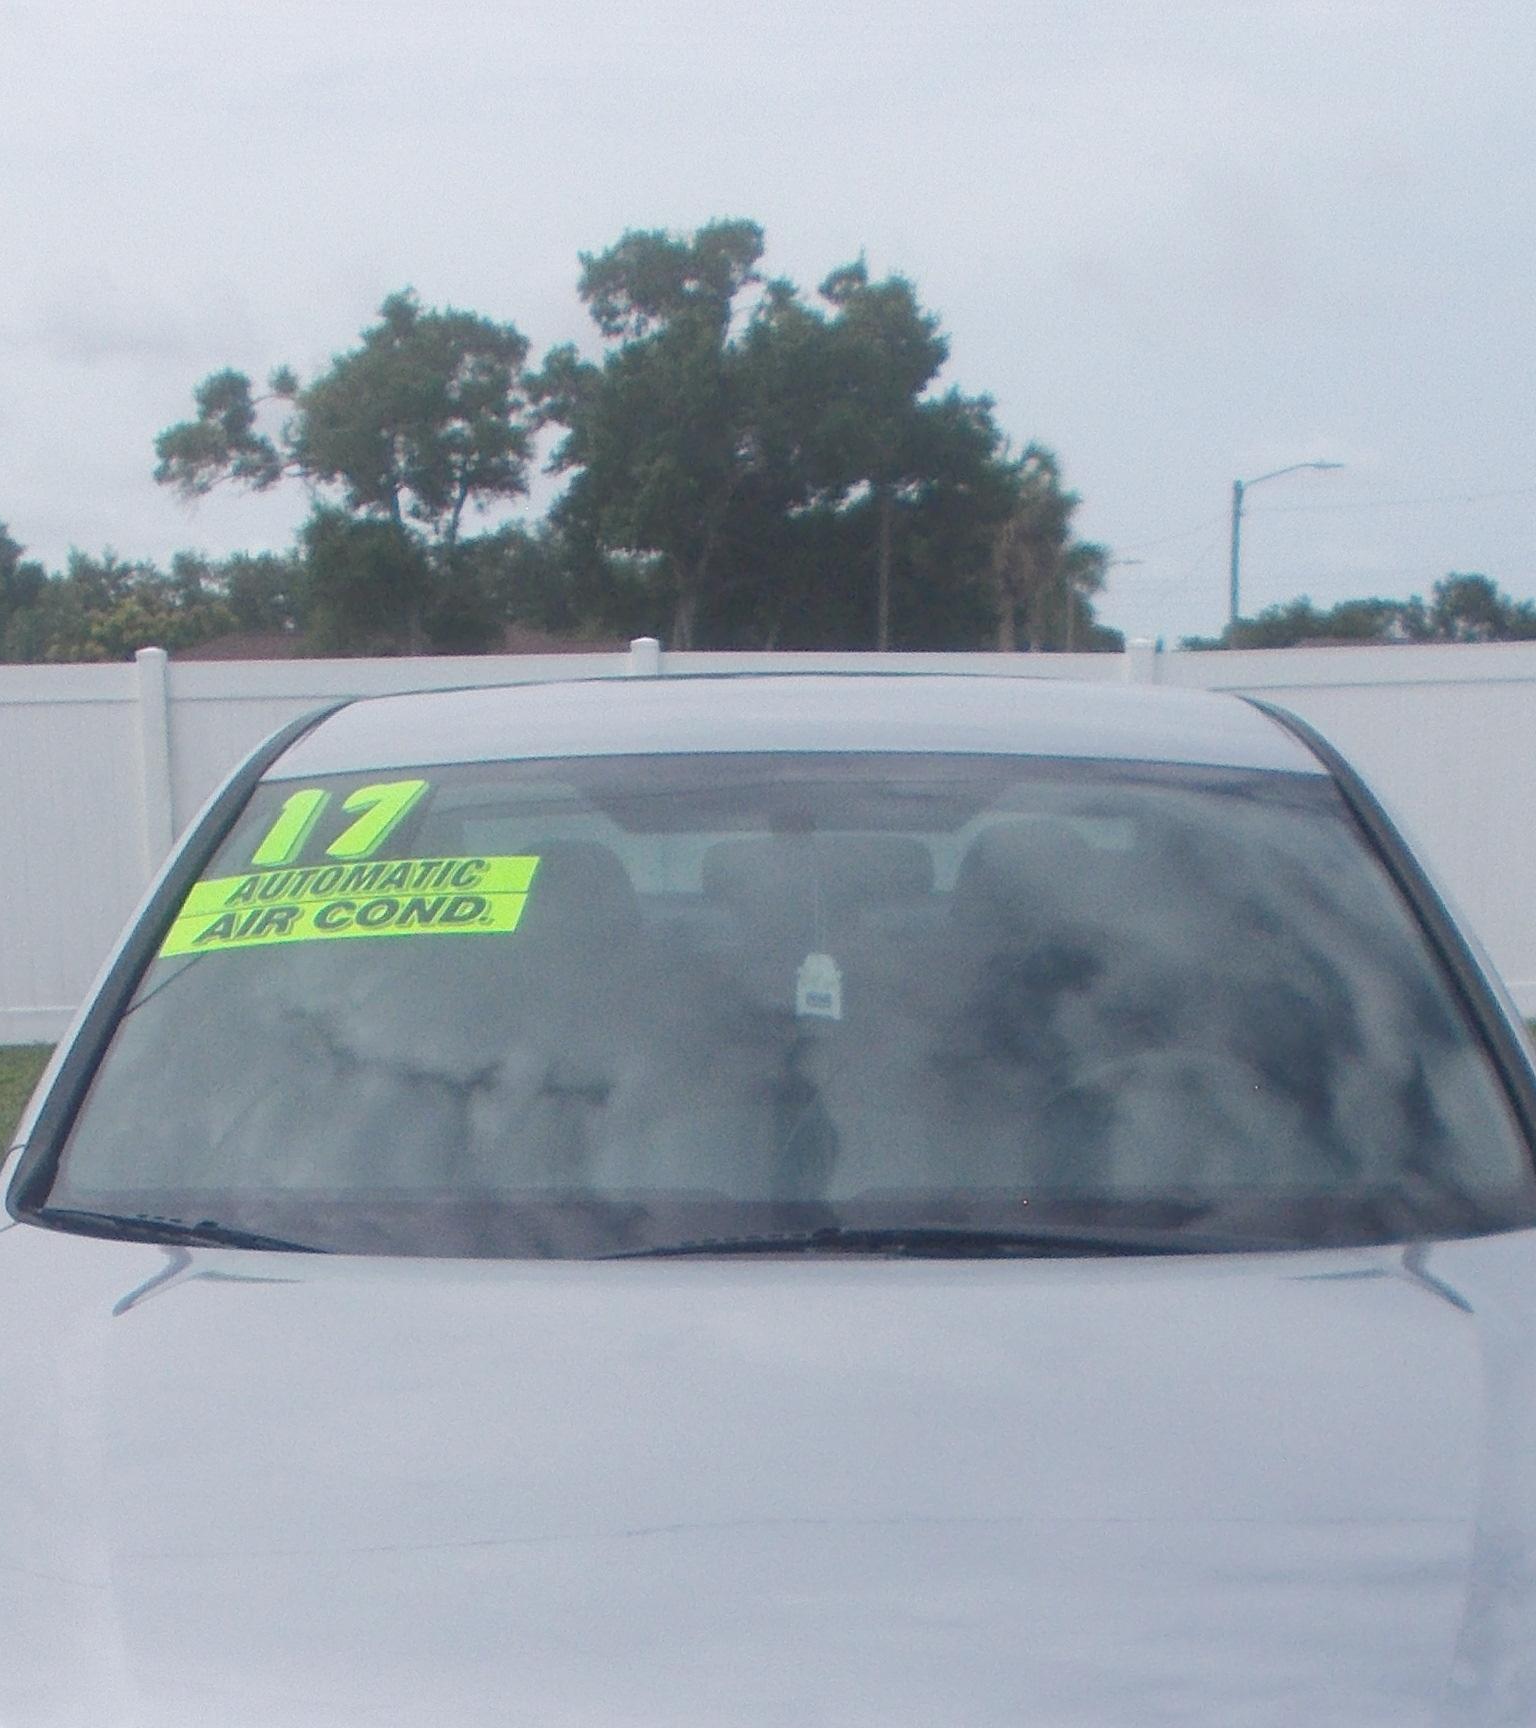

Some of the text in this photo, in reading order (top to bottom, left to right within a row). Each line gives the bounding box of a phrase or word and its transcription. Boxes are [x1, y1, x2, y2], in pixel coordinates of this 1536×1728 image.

[252, 779, 430, 866] 17
[225, 859, 492, 906] AUTOMATIC
[192, 896, 494, 945] AIR COND.
